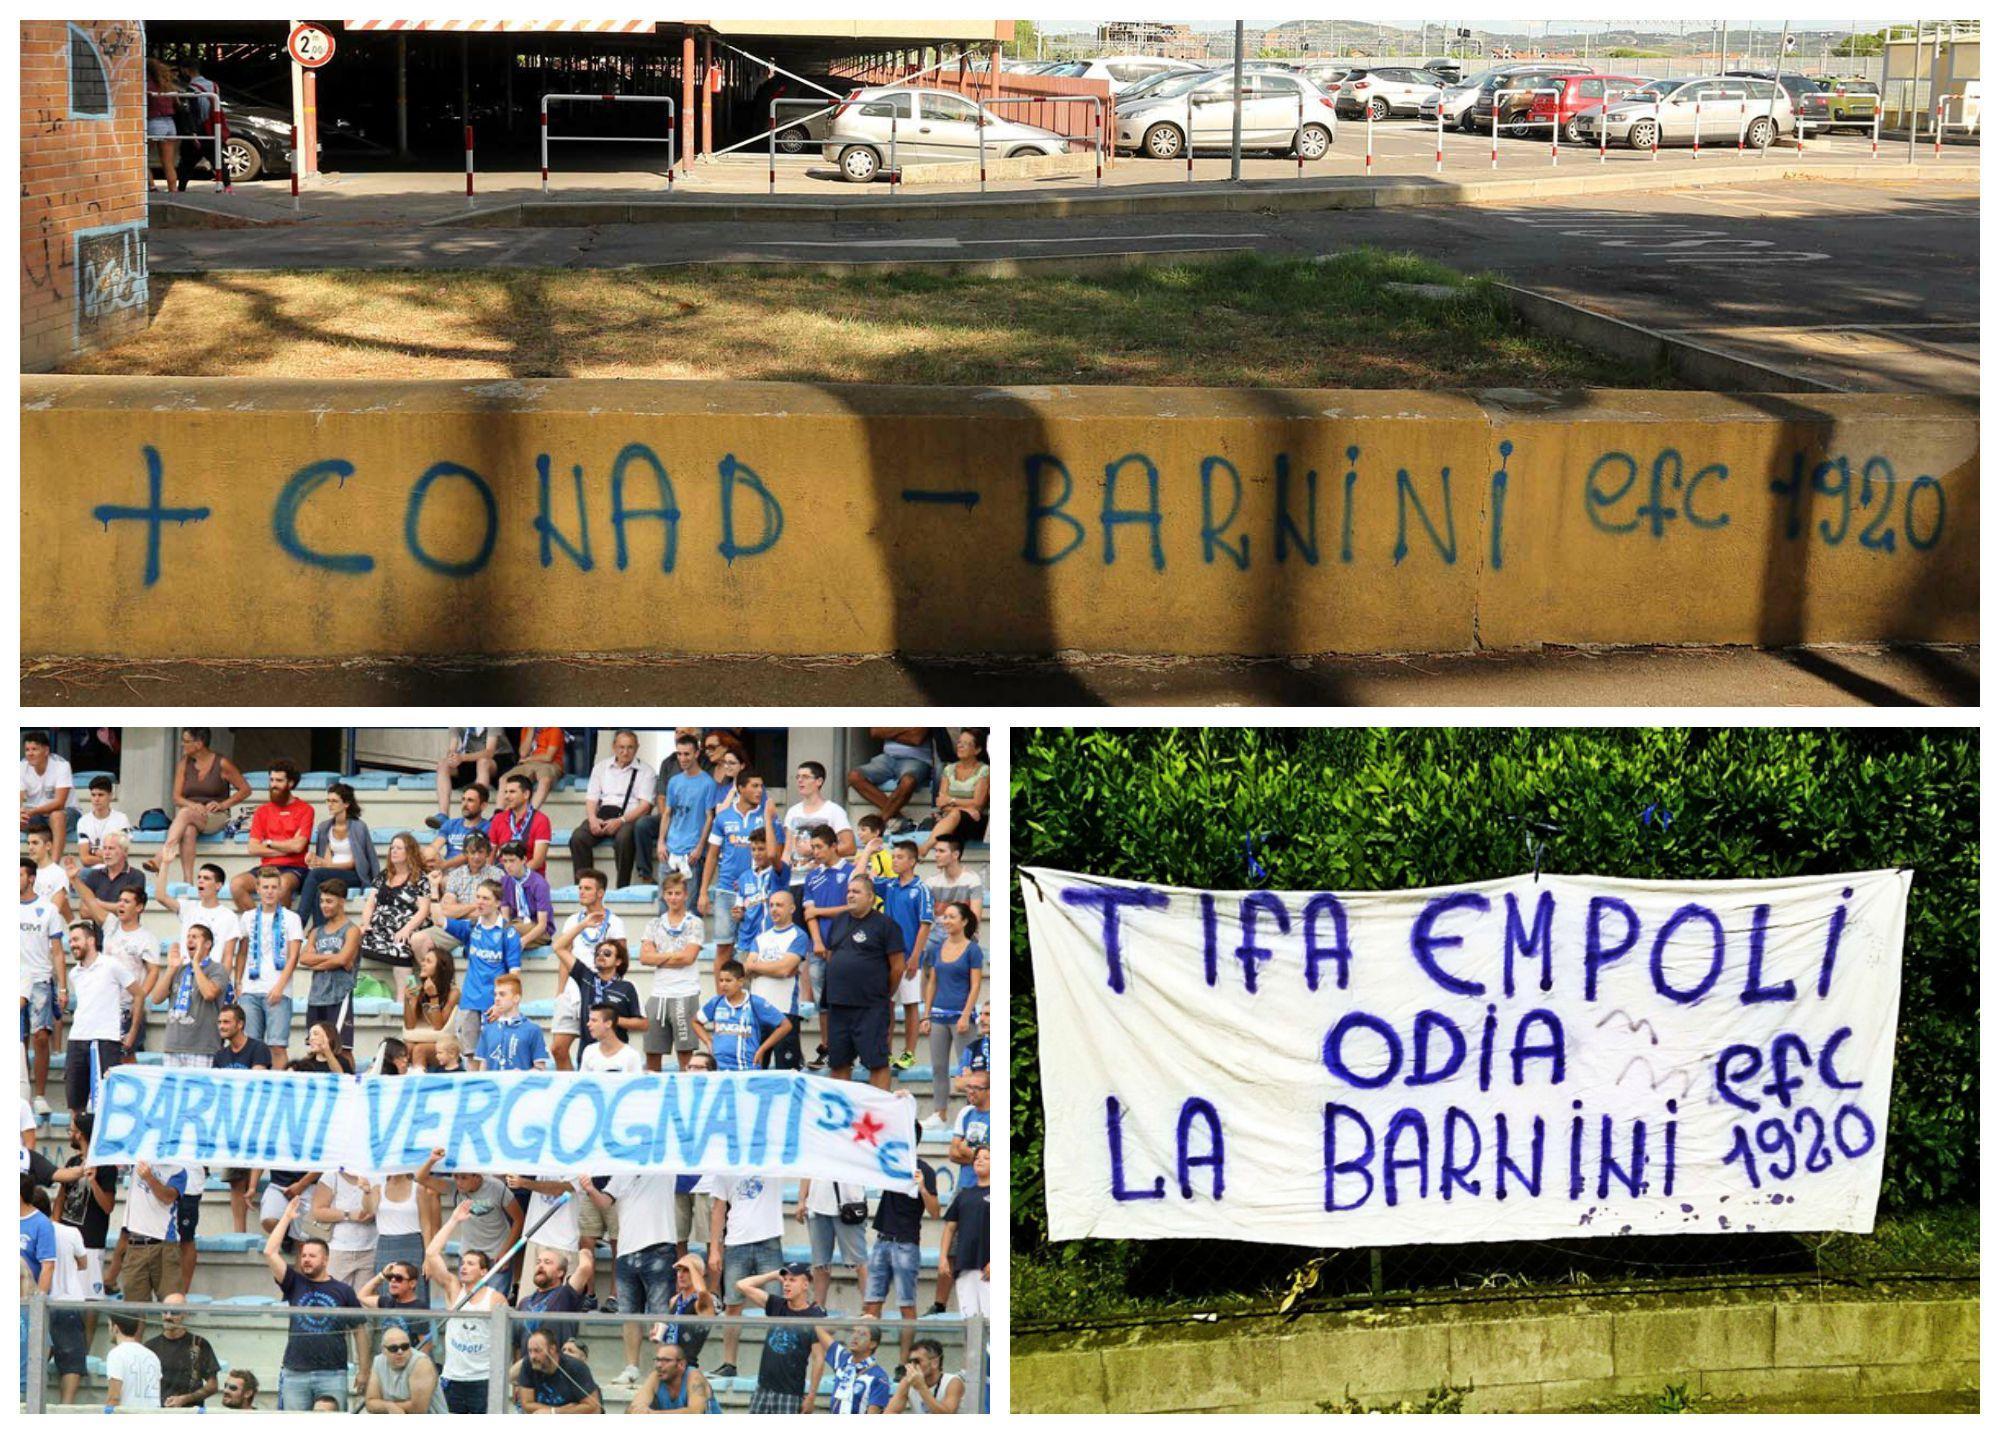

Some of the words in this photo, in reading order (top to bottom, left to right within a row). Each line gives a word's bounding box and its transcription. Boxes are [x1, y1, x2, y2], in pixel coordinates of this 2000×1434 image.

[300, 35, 310, 53] 2
[272, 443, 783, 577] CONAD
[1584, 448, 1732, 538] efc
[1769, 449, 1946, 554] 1920
[1061, 888, 1352, 995] TIFA
[1716, 1026, 1864, 1114] efc
[94, 1074, 340, 1161] BARNINI
[367, 1074, 807, 1170] VERGOGNATI
[1106, 1096, 1226, 1202] LA
[1721, 1104, 1876, 1189] 1920
